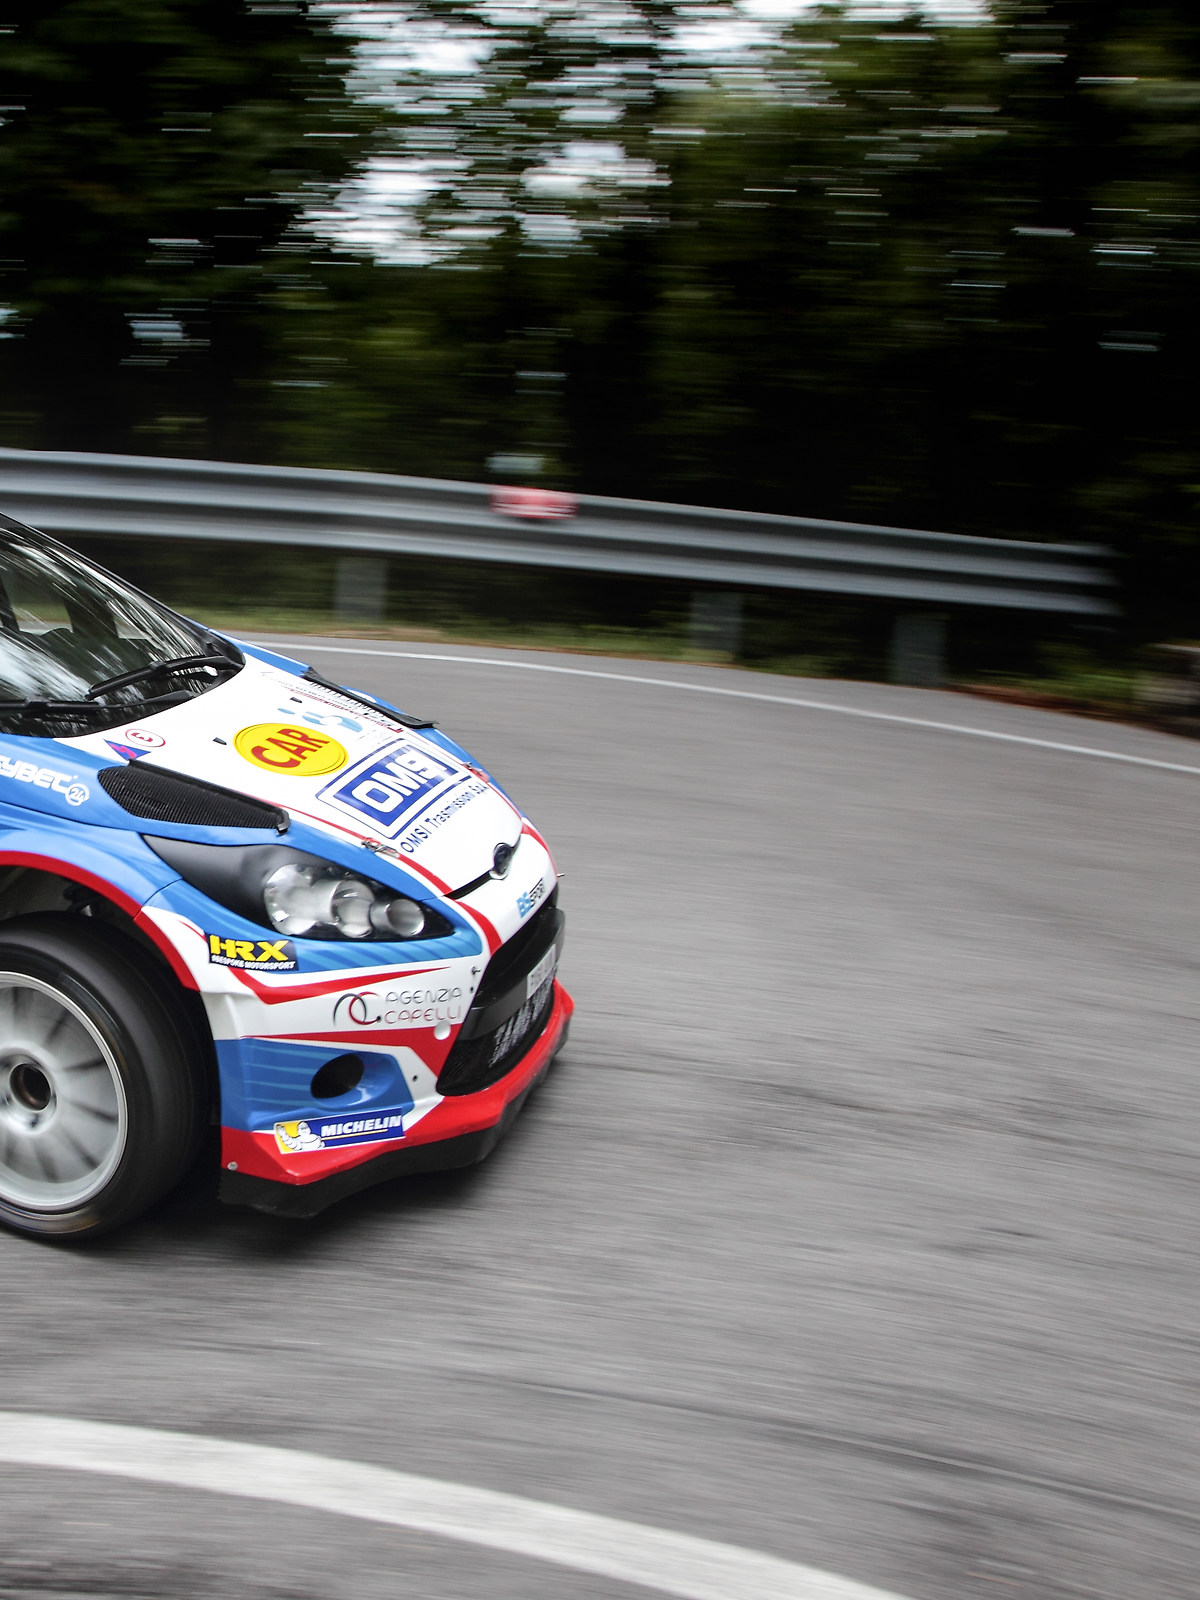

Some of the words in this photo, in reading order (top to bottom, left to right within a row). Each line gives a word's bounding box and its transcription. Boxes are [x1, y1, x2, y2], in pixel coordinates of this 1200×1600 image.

[251, 728, 330, 768] CAR
[400, 824, 432, 853] OMSI
[209, 934, 289, 962] HRX
[245, 961, 296, 970] MOTORSPORT
[385, 987, 462, 1005] AGENZIA
[384, 1005, 462, 1024] CAPELLI
[321, 1115, 402, 1137] MICHELIN
